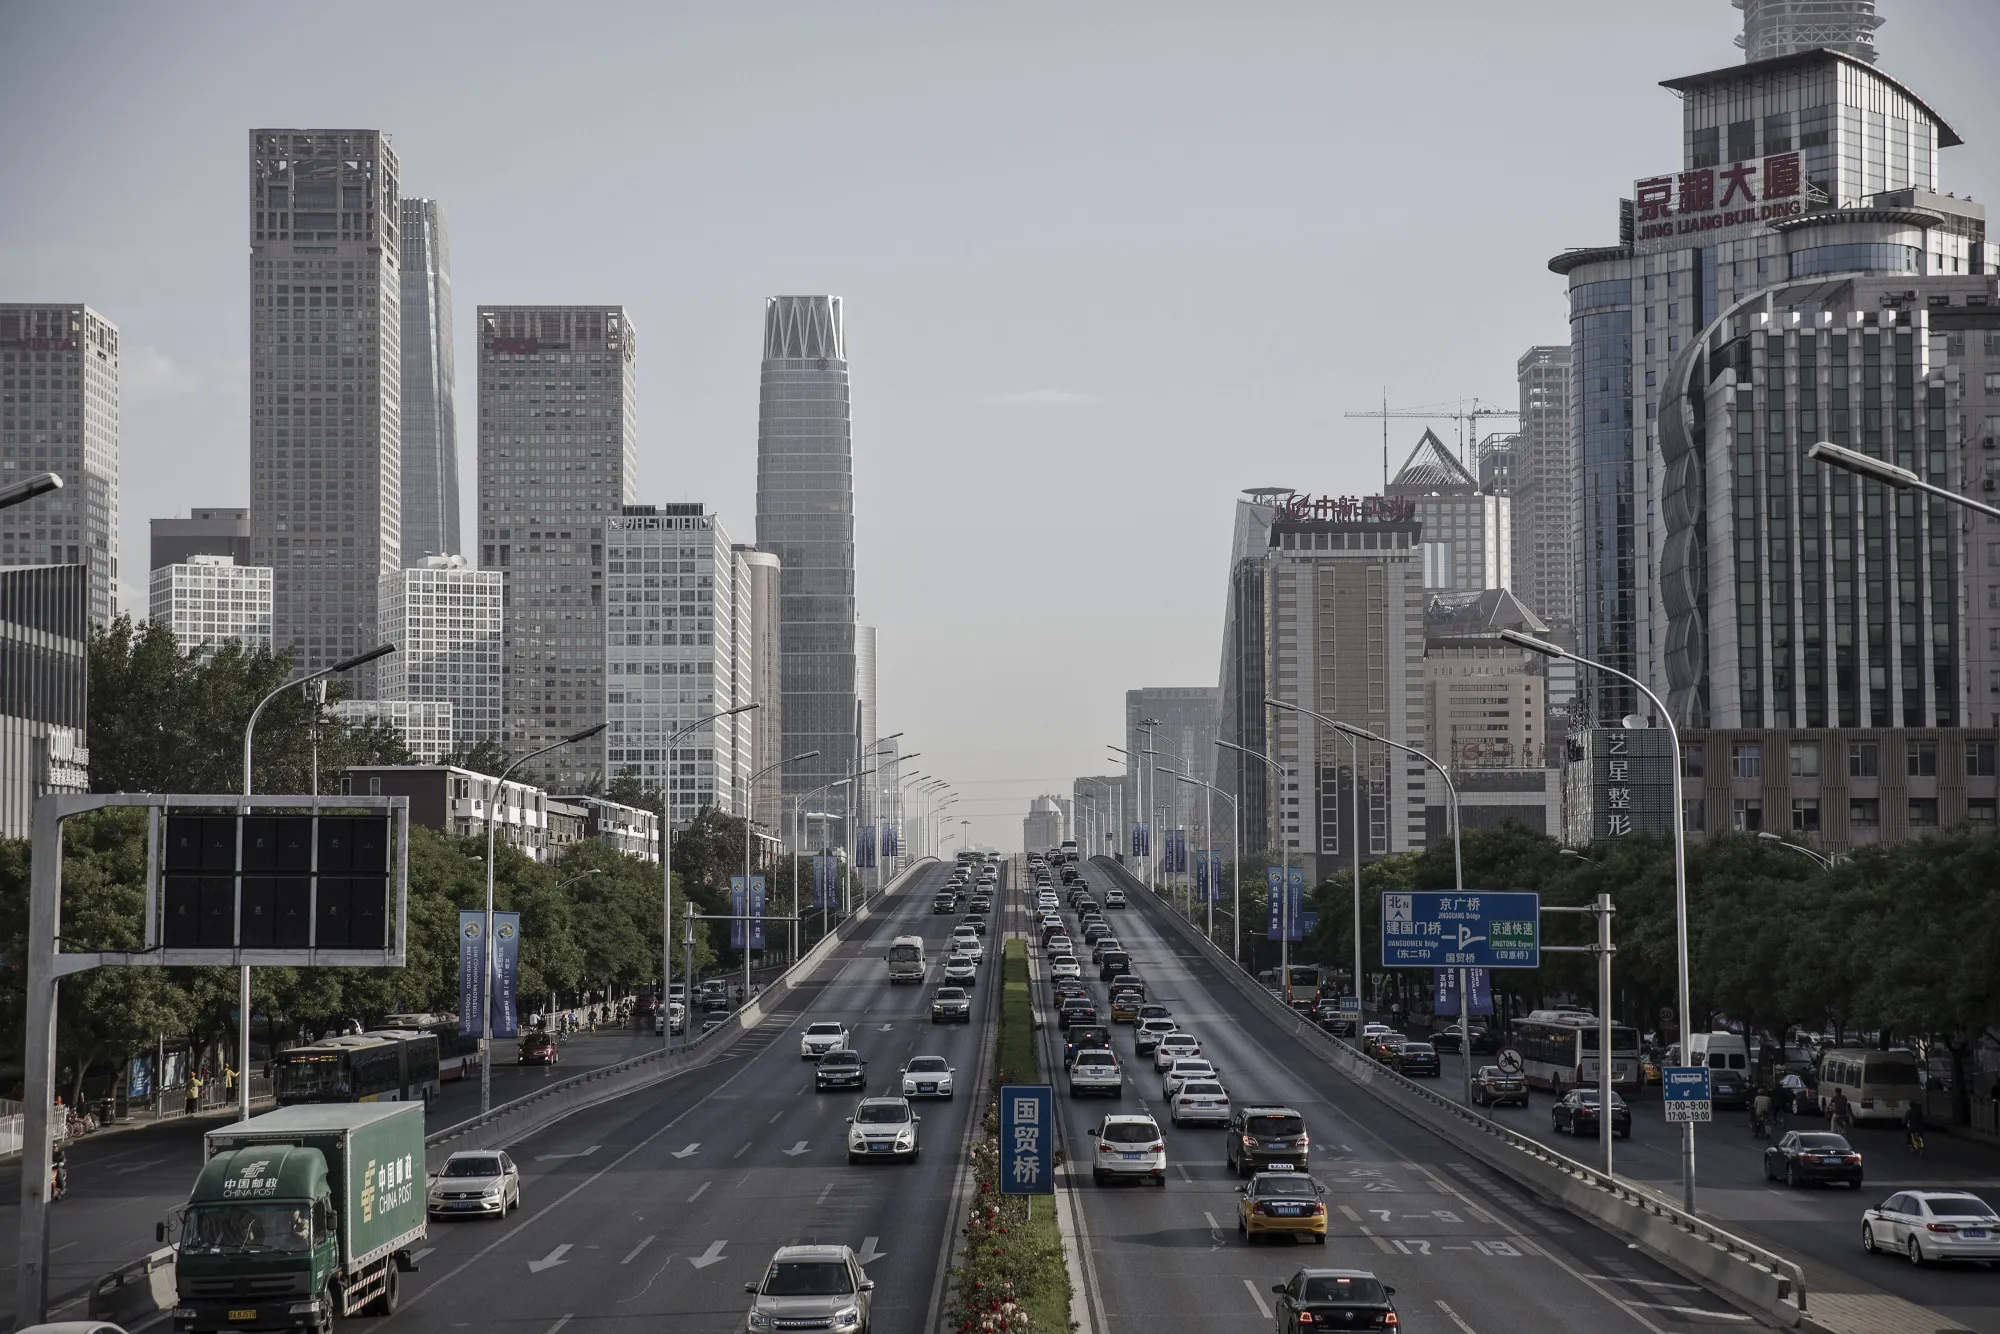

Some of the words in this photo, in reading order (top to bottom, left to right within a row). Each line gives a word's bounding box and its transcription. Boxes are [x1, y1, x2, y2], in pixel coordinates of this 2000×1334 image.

[1637, 152, 1800, 221] 京粮大厦
[1637, 222, 1673, 240] JING
[1677, 214, 1722, 235] LIANG
[1608, 733, 1632, 837] 艺星整形
[1389, 896, 1401, 909] 北
[1403, 901, 1409, 909] N
[1440, 897, 1481, 911] 京广桥
[1466, 912, 1481, 920] Bridge
[1386, 921, 1441, 935] 建国门桥
[1492, 922, 1533, 936] 京通快速
[1424, 940, 1439, 949] Bridge
[1397, 949, 1431, 959] (东二环)
[1445, 953, 1476, 964] 国贸桥
[1661, 1010, 1672, 1018] 50
[1667, 1102, 1709, 1110] 7:00-9:00
[1668, 1112, 1710, 1120] 17:00-19:00
[1013, 1098, 1040, 1183] 国贸桥
[379, 1152, 412, 1193] 中国邮政
[224, 1178, 278, 1189] 中国邮政
[223, 1190, 251, 1198] CHINA
[253, 1188, 276, 1196] POST
[380, 1190, 398, 1215] CHINA
[398, 1182, 412, 1205] POST
